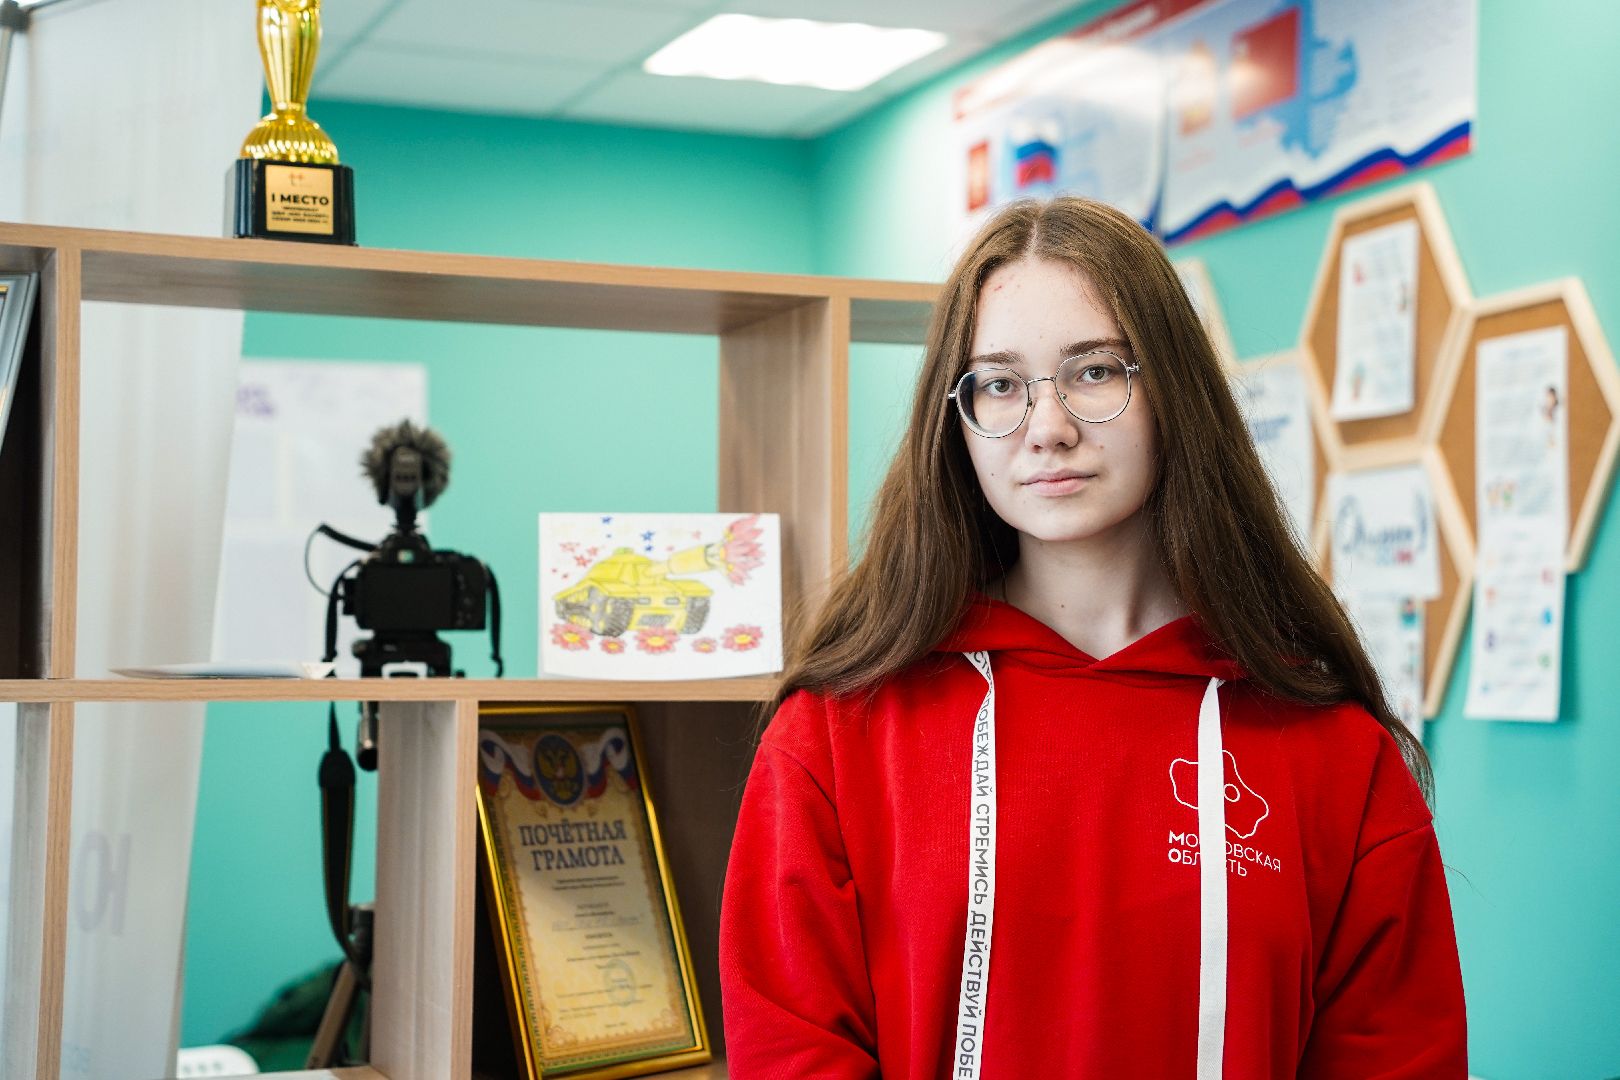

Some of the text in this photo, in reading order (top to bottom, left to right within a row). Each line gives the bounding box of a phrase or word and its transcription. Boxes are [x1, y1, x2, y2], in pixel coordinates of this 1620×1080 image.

[271, 193, 329, 205] I МЕСТО
[519, 819, 626, 846] ПОЧЁТНАЯ
[531, 845, 625, 870] ГРАМОТА
[974, 804, 990, 905] СТРЕМИСЬ
[1168, 830, 1281, 873] МООВСКАЯ
[1168, 848, 1248, 877] ОБЛТЬ
[963, 910, 988, 1018] ДЕЙСТВУЙ
[958, 1023, 977, 1080] ПОБЕ
